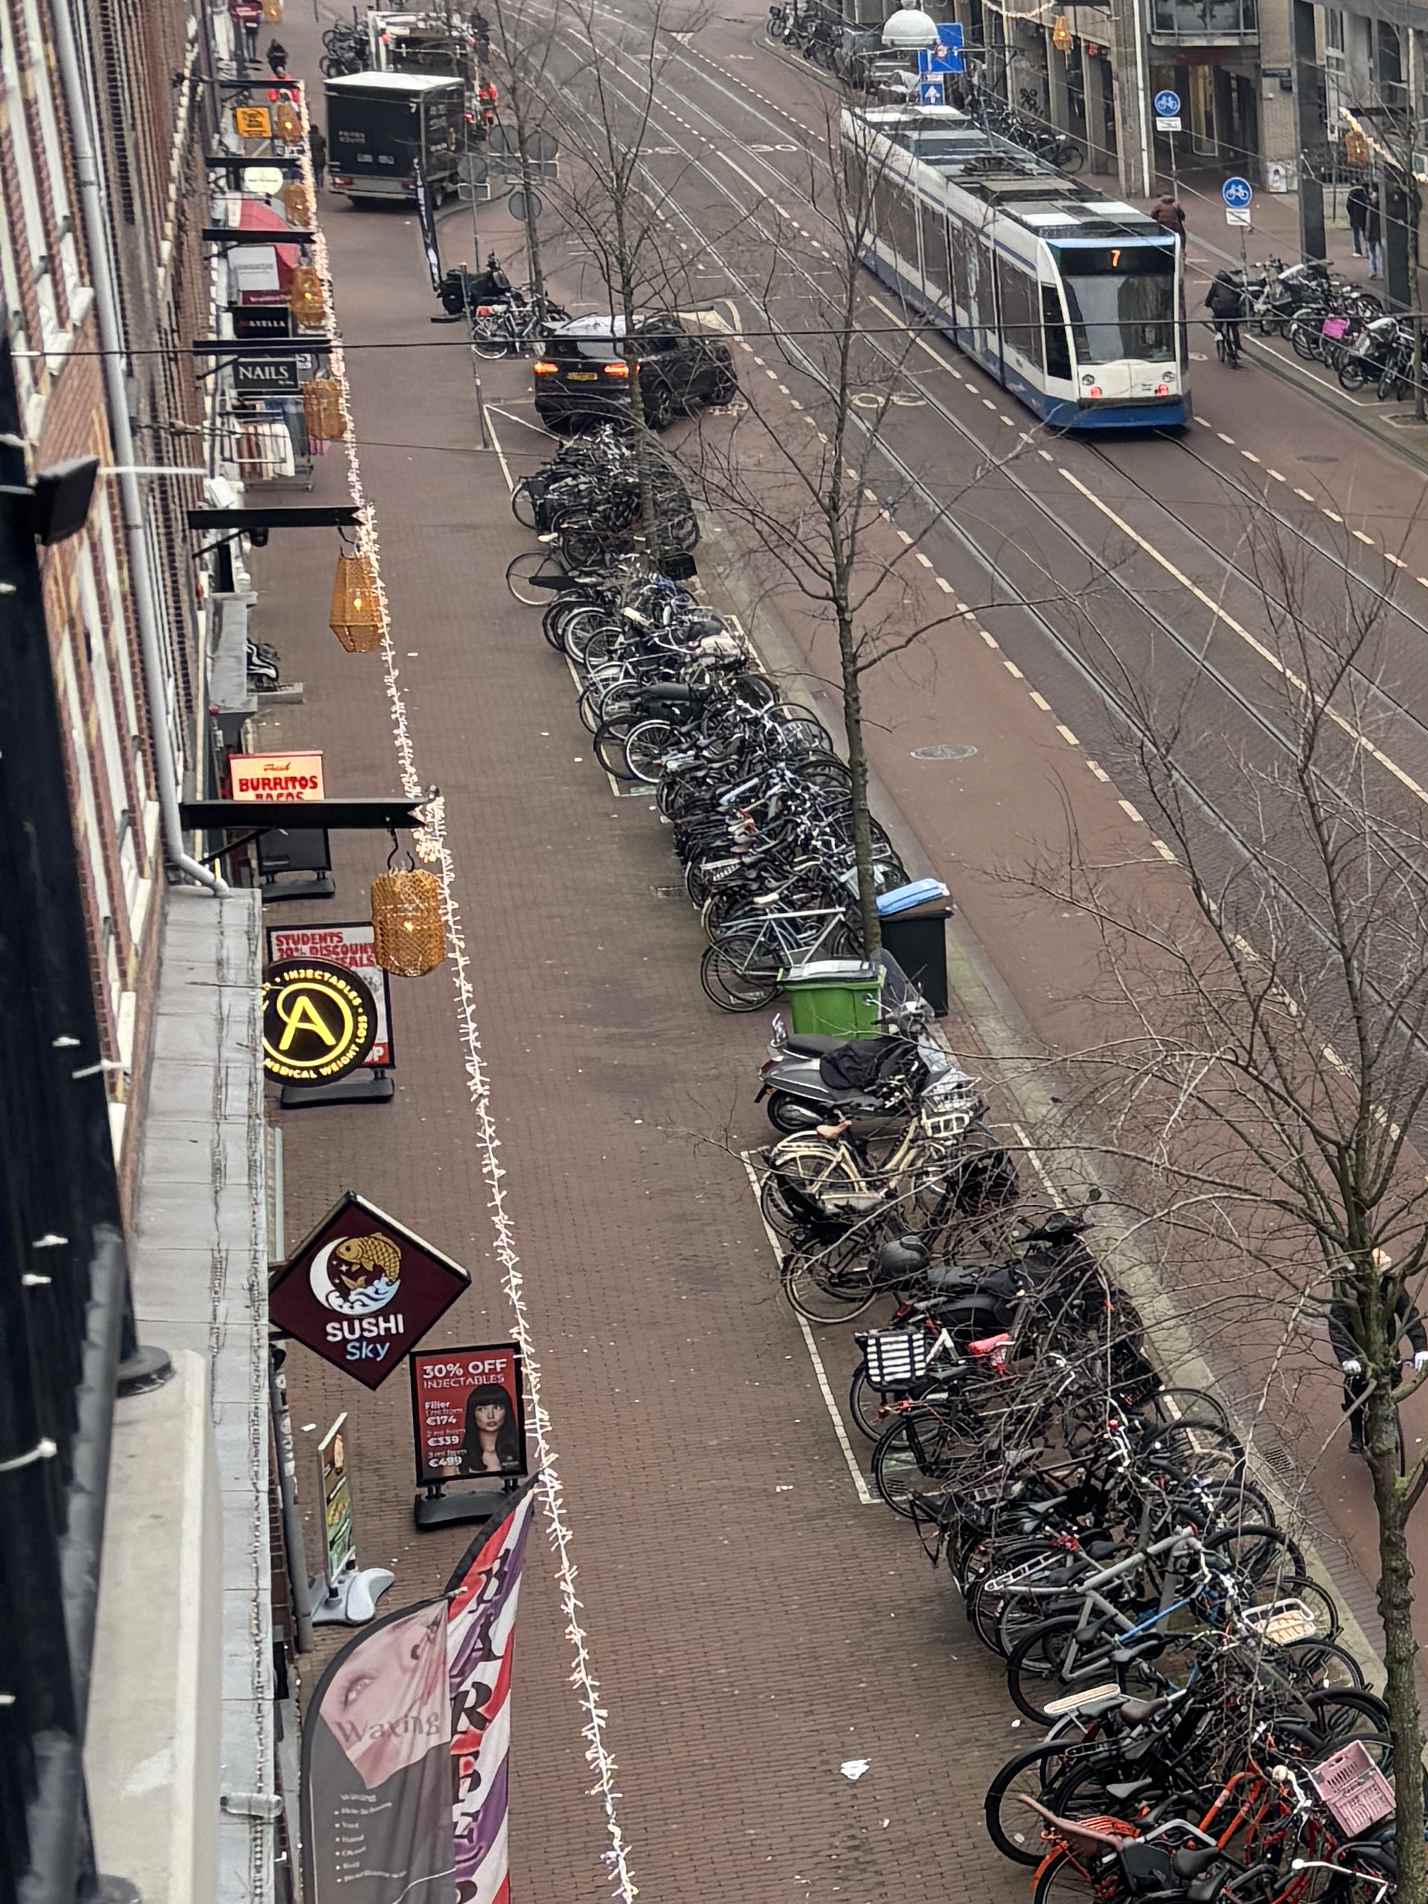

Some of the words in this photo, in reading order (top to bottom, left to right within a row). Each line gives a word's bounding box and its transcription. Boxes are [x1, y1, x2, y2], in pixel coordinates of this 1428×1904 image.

[239, 366, 289, 380] NAILS
[239, 775, 318, 792] BURRITOS
[275, 932, 344, 946] STUDENTS
[355, 1015, 368, 1044] LOSS
[326, 1313, 404, 1342] SUSHI
[346, 1341, 390, 1361] Sky
[423, 1362, 463, 1378] 30%
[468, 1359, 507, 1374] OFF
[423, 1374, 505, 1389] INJECTABLES
[334, 1710, 442, 1745] Waxing
